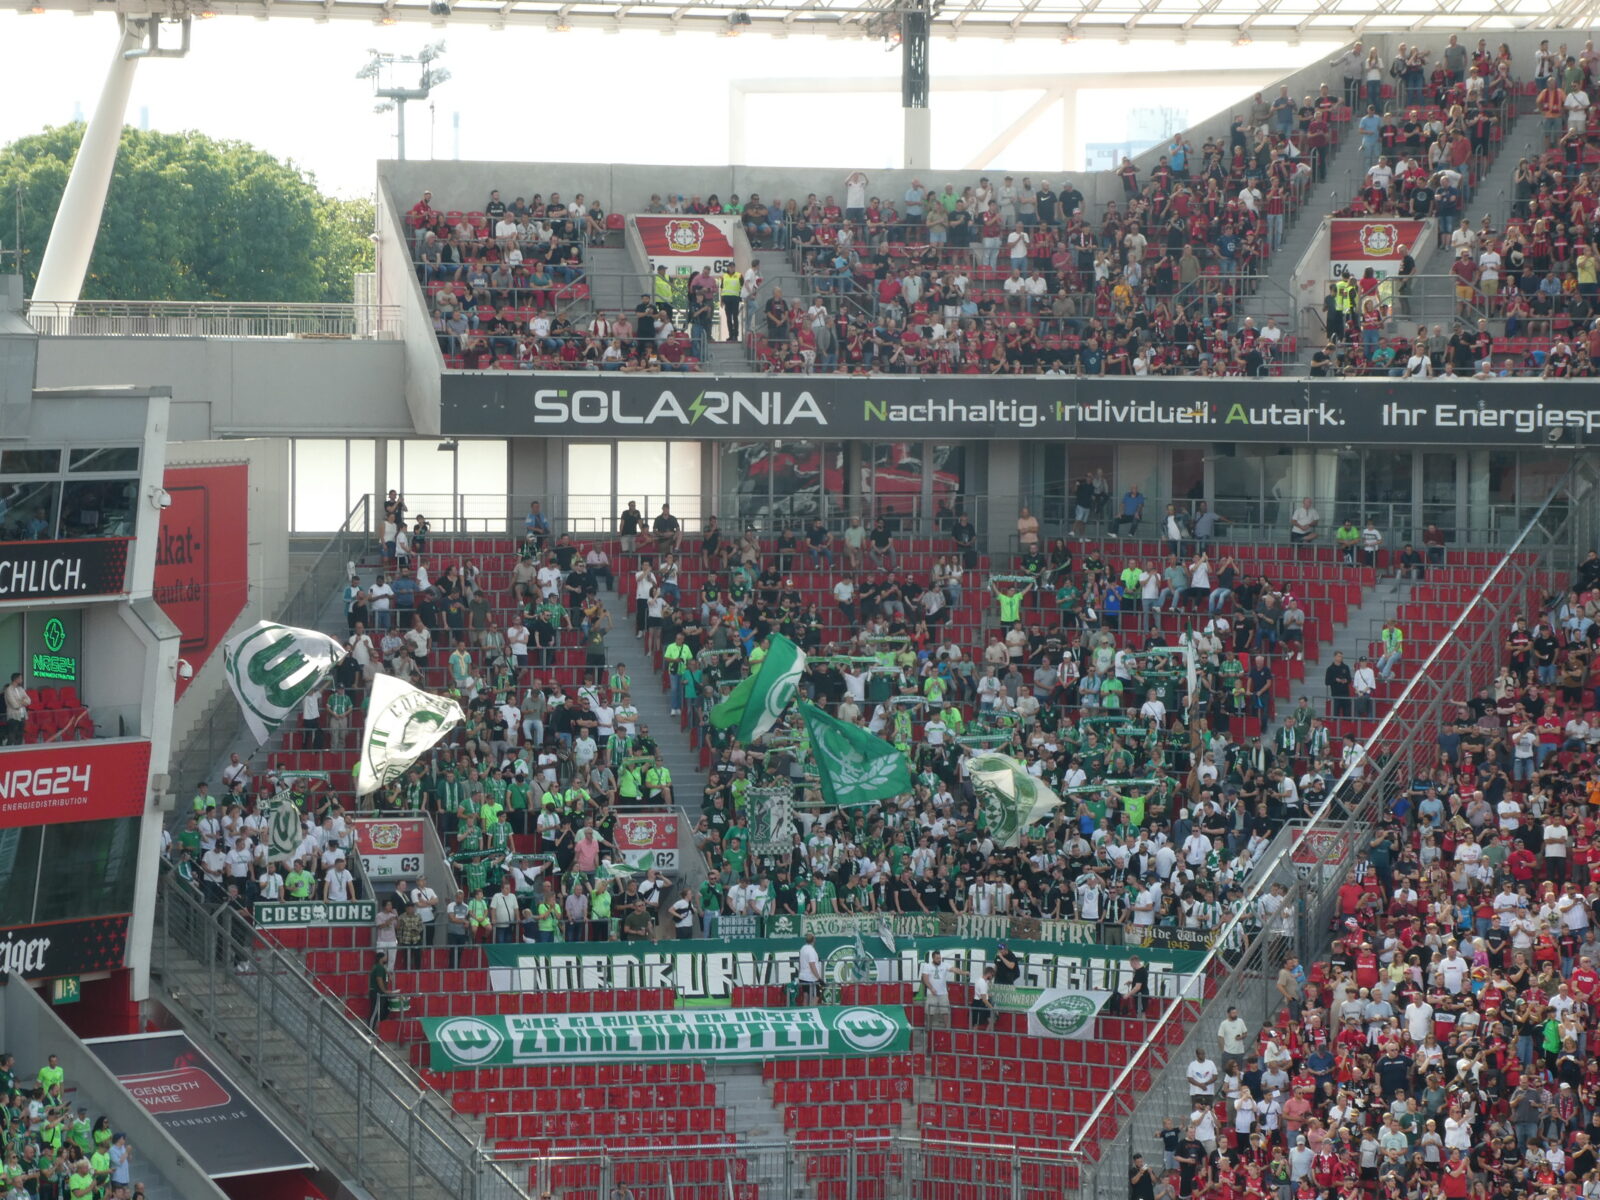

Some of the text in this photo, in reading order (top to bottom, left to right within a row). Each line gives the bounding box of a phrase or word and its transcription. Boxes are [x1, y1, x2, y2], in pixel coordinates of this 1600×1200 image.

[534, 389, 828, 425] SOLARNIA
[864, 398, 1047, 427] Nachhaltig.
[1225, 401, 1346, 426] Autark.
[1383, 403, 1427, 427] Ihr
[401, 857, 420, 872] G3
[656, 852, 675, 867] G2
[512, 1016, 561, 1029] WIR
